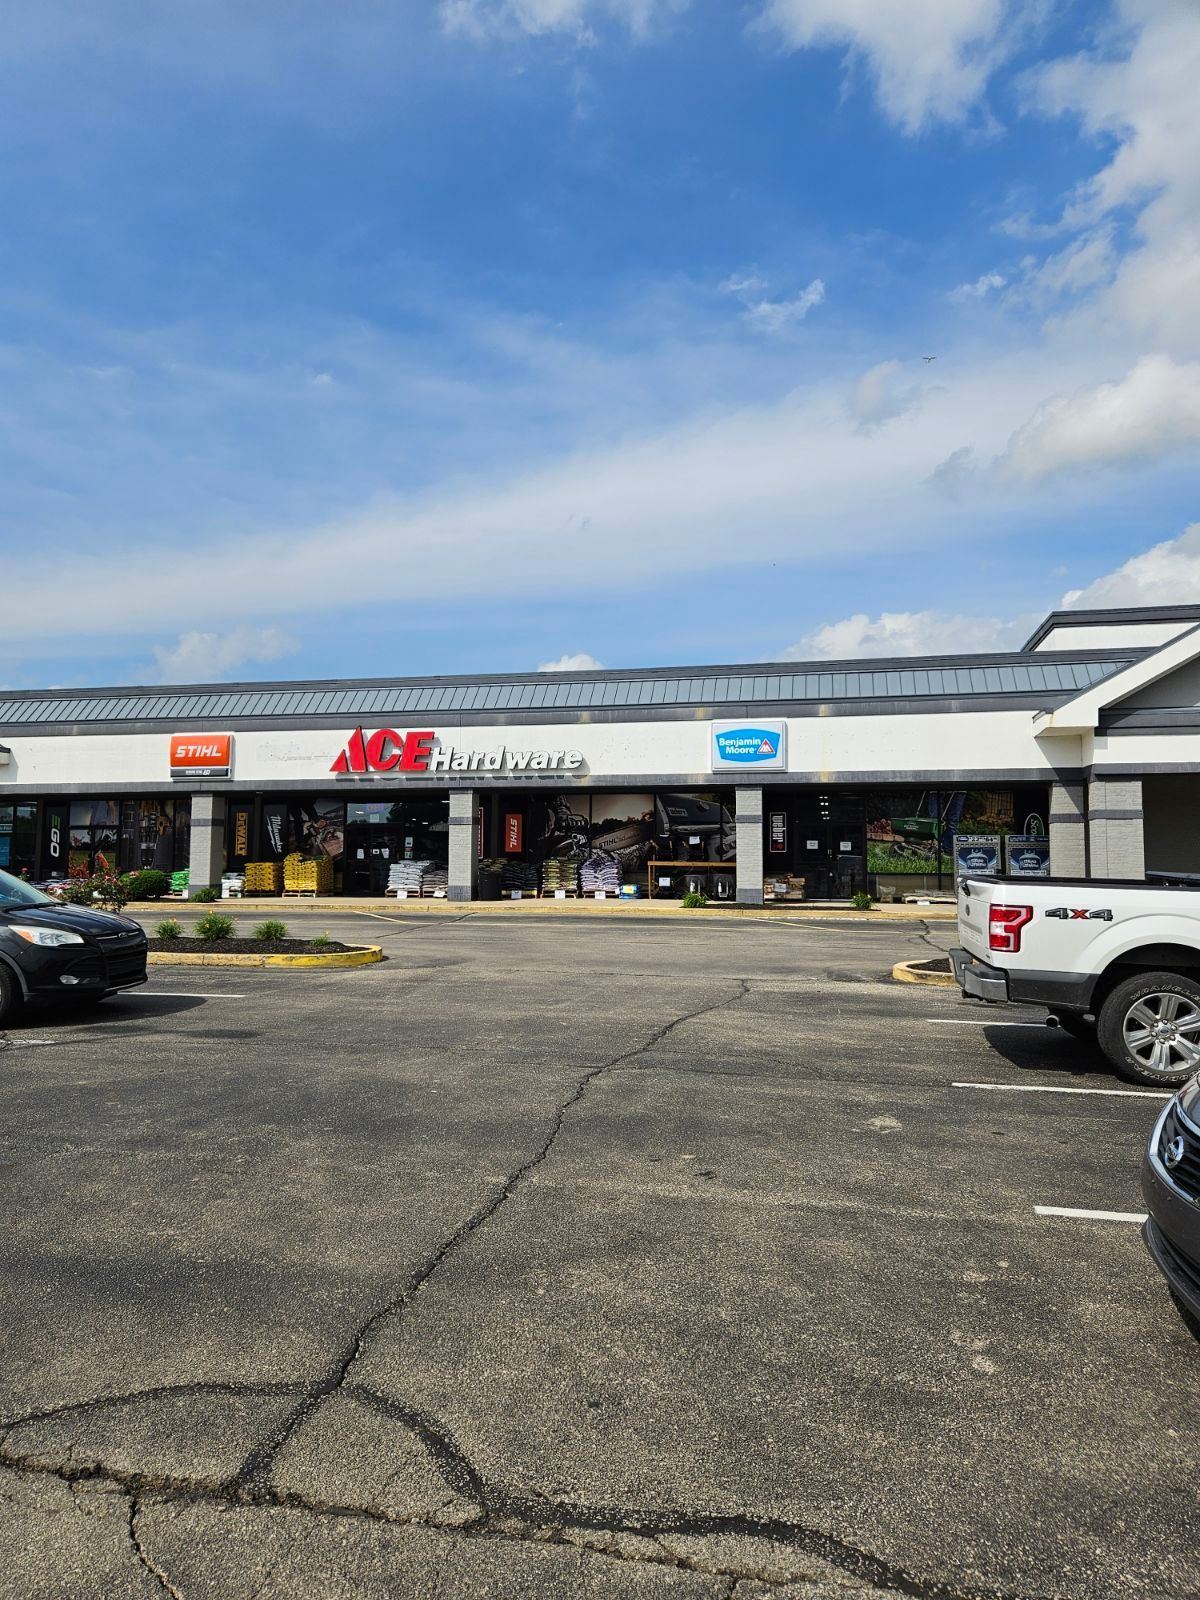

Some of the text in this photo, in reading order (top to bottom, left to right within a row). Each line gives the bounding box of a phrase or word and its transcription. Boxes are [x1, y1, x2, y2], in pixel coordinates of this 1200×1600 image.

[175, 744, 222, 758] STIHL
[329, 725, 583, 773] ACE Hardware
[719, 737, 761, 747] Benjamin
[725, 746, 755, 754] Moore
[50, 814, 61, 858] EGO
[270, 815, 283, 853] Milwaukee
[509, 817, 518, 848] STIHL
[598, 837, 618, 848] STIHL
[772, 814, 787, 843] weber
